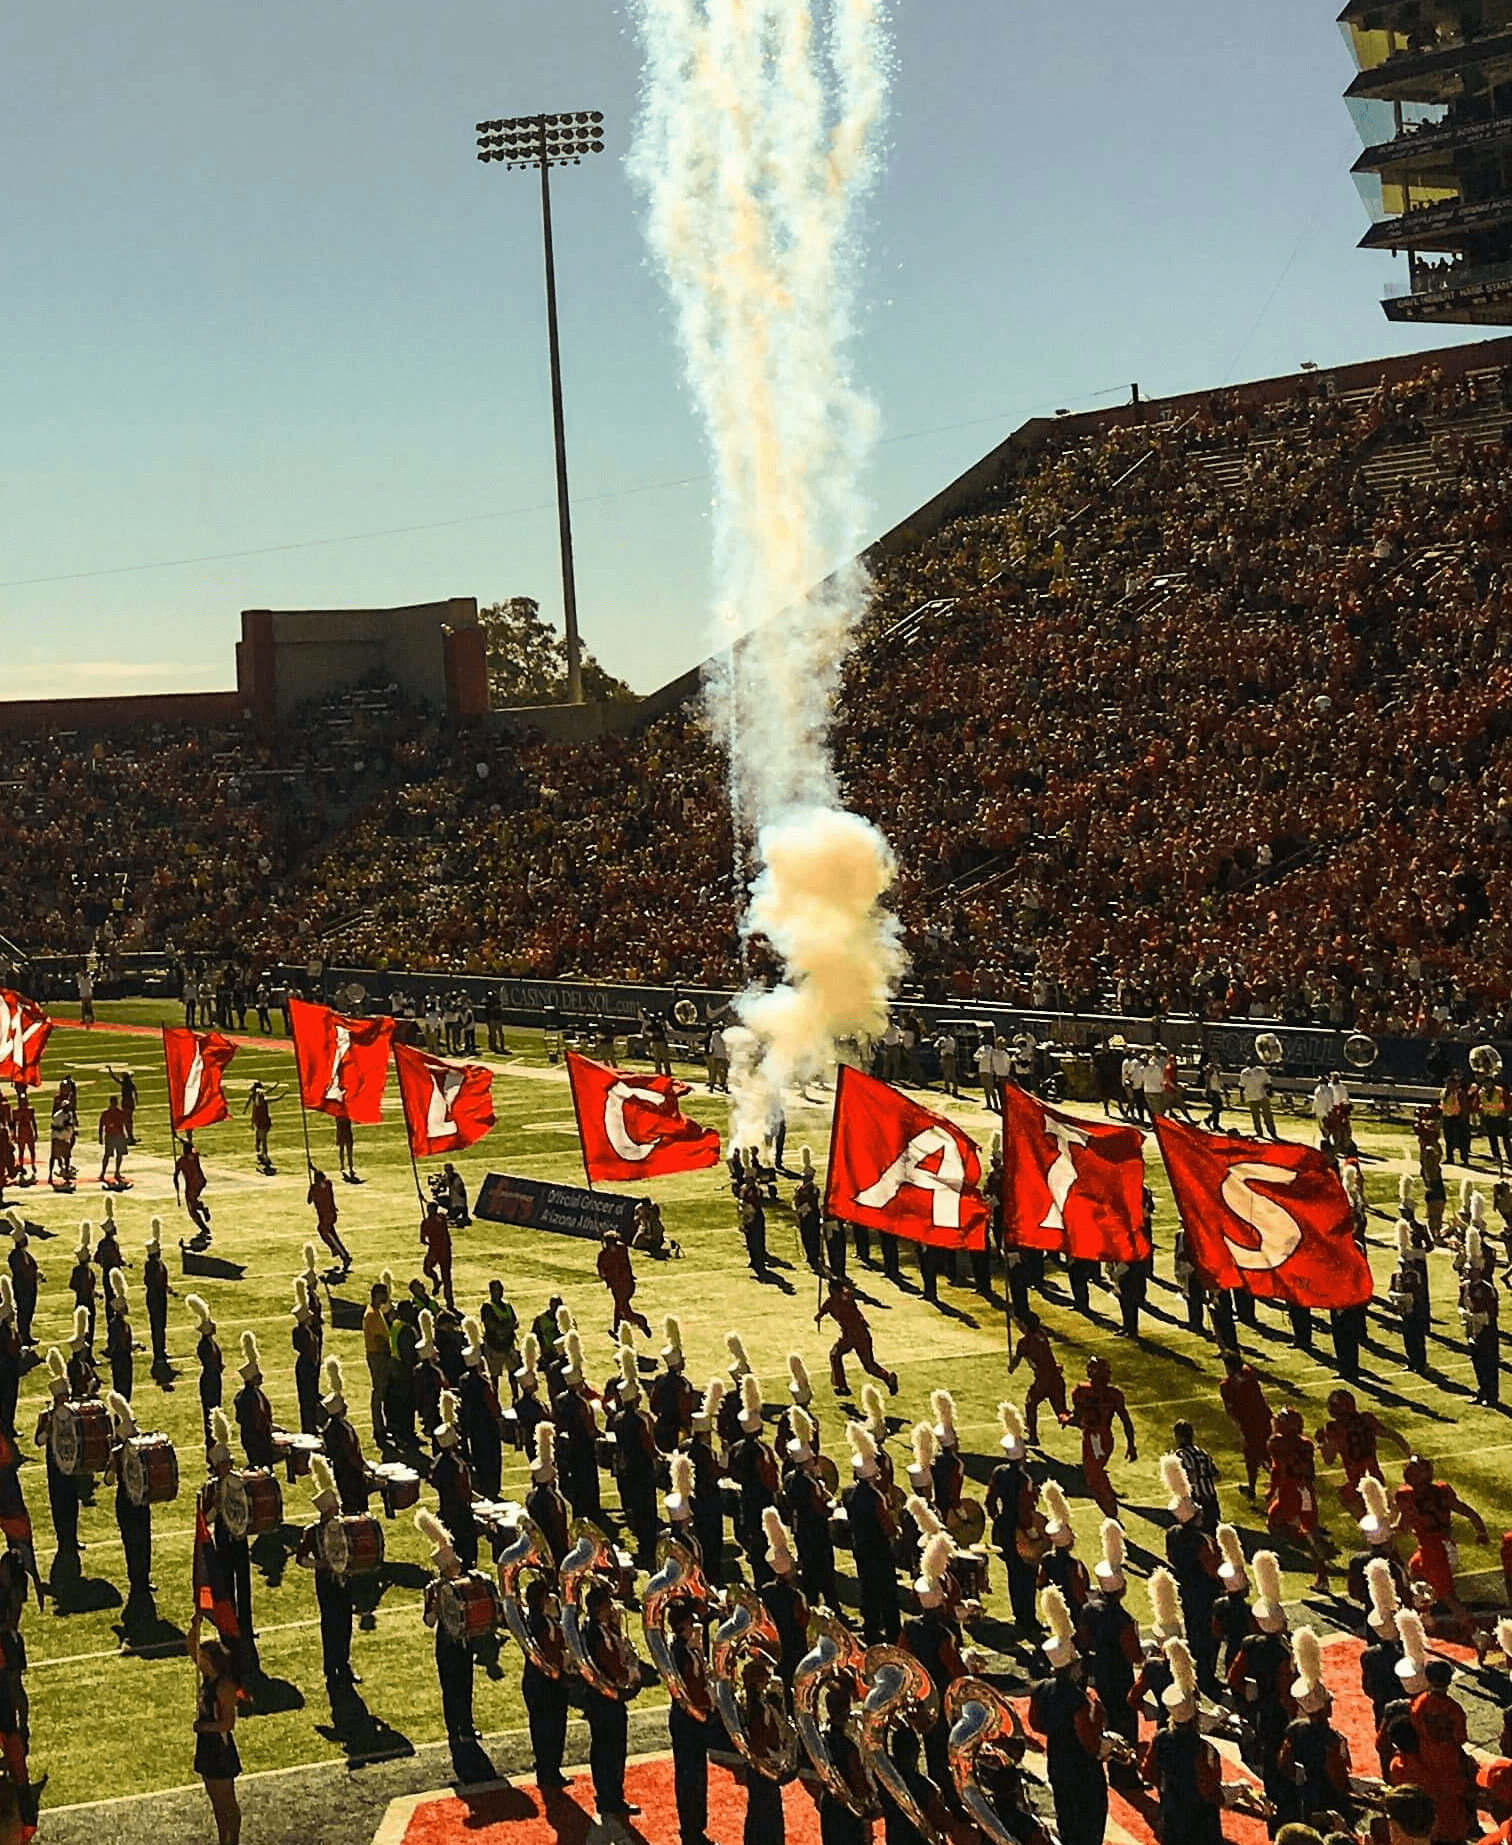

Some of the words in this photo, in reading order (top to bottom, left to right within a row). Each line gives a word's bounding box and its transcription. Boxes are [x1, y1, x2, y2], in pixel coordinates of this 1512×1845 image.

[510, 987, 559, 1008] CASINO
[561, 989, 586, 1010] DEL
[604, 1081, 666, 1161] C
[854, 1125, 964, 1228] A
[1221, 1162, 1302, 1269] S
